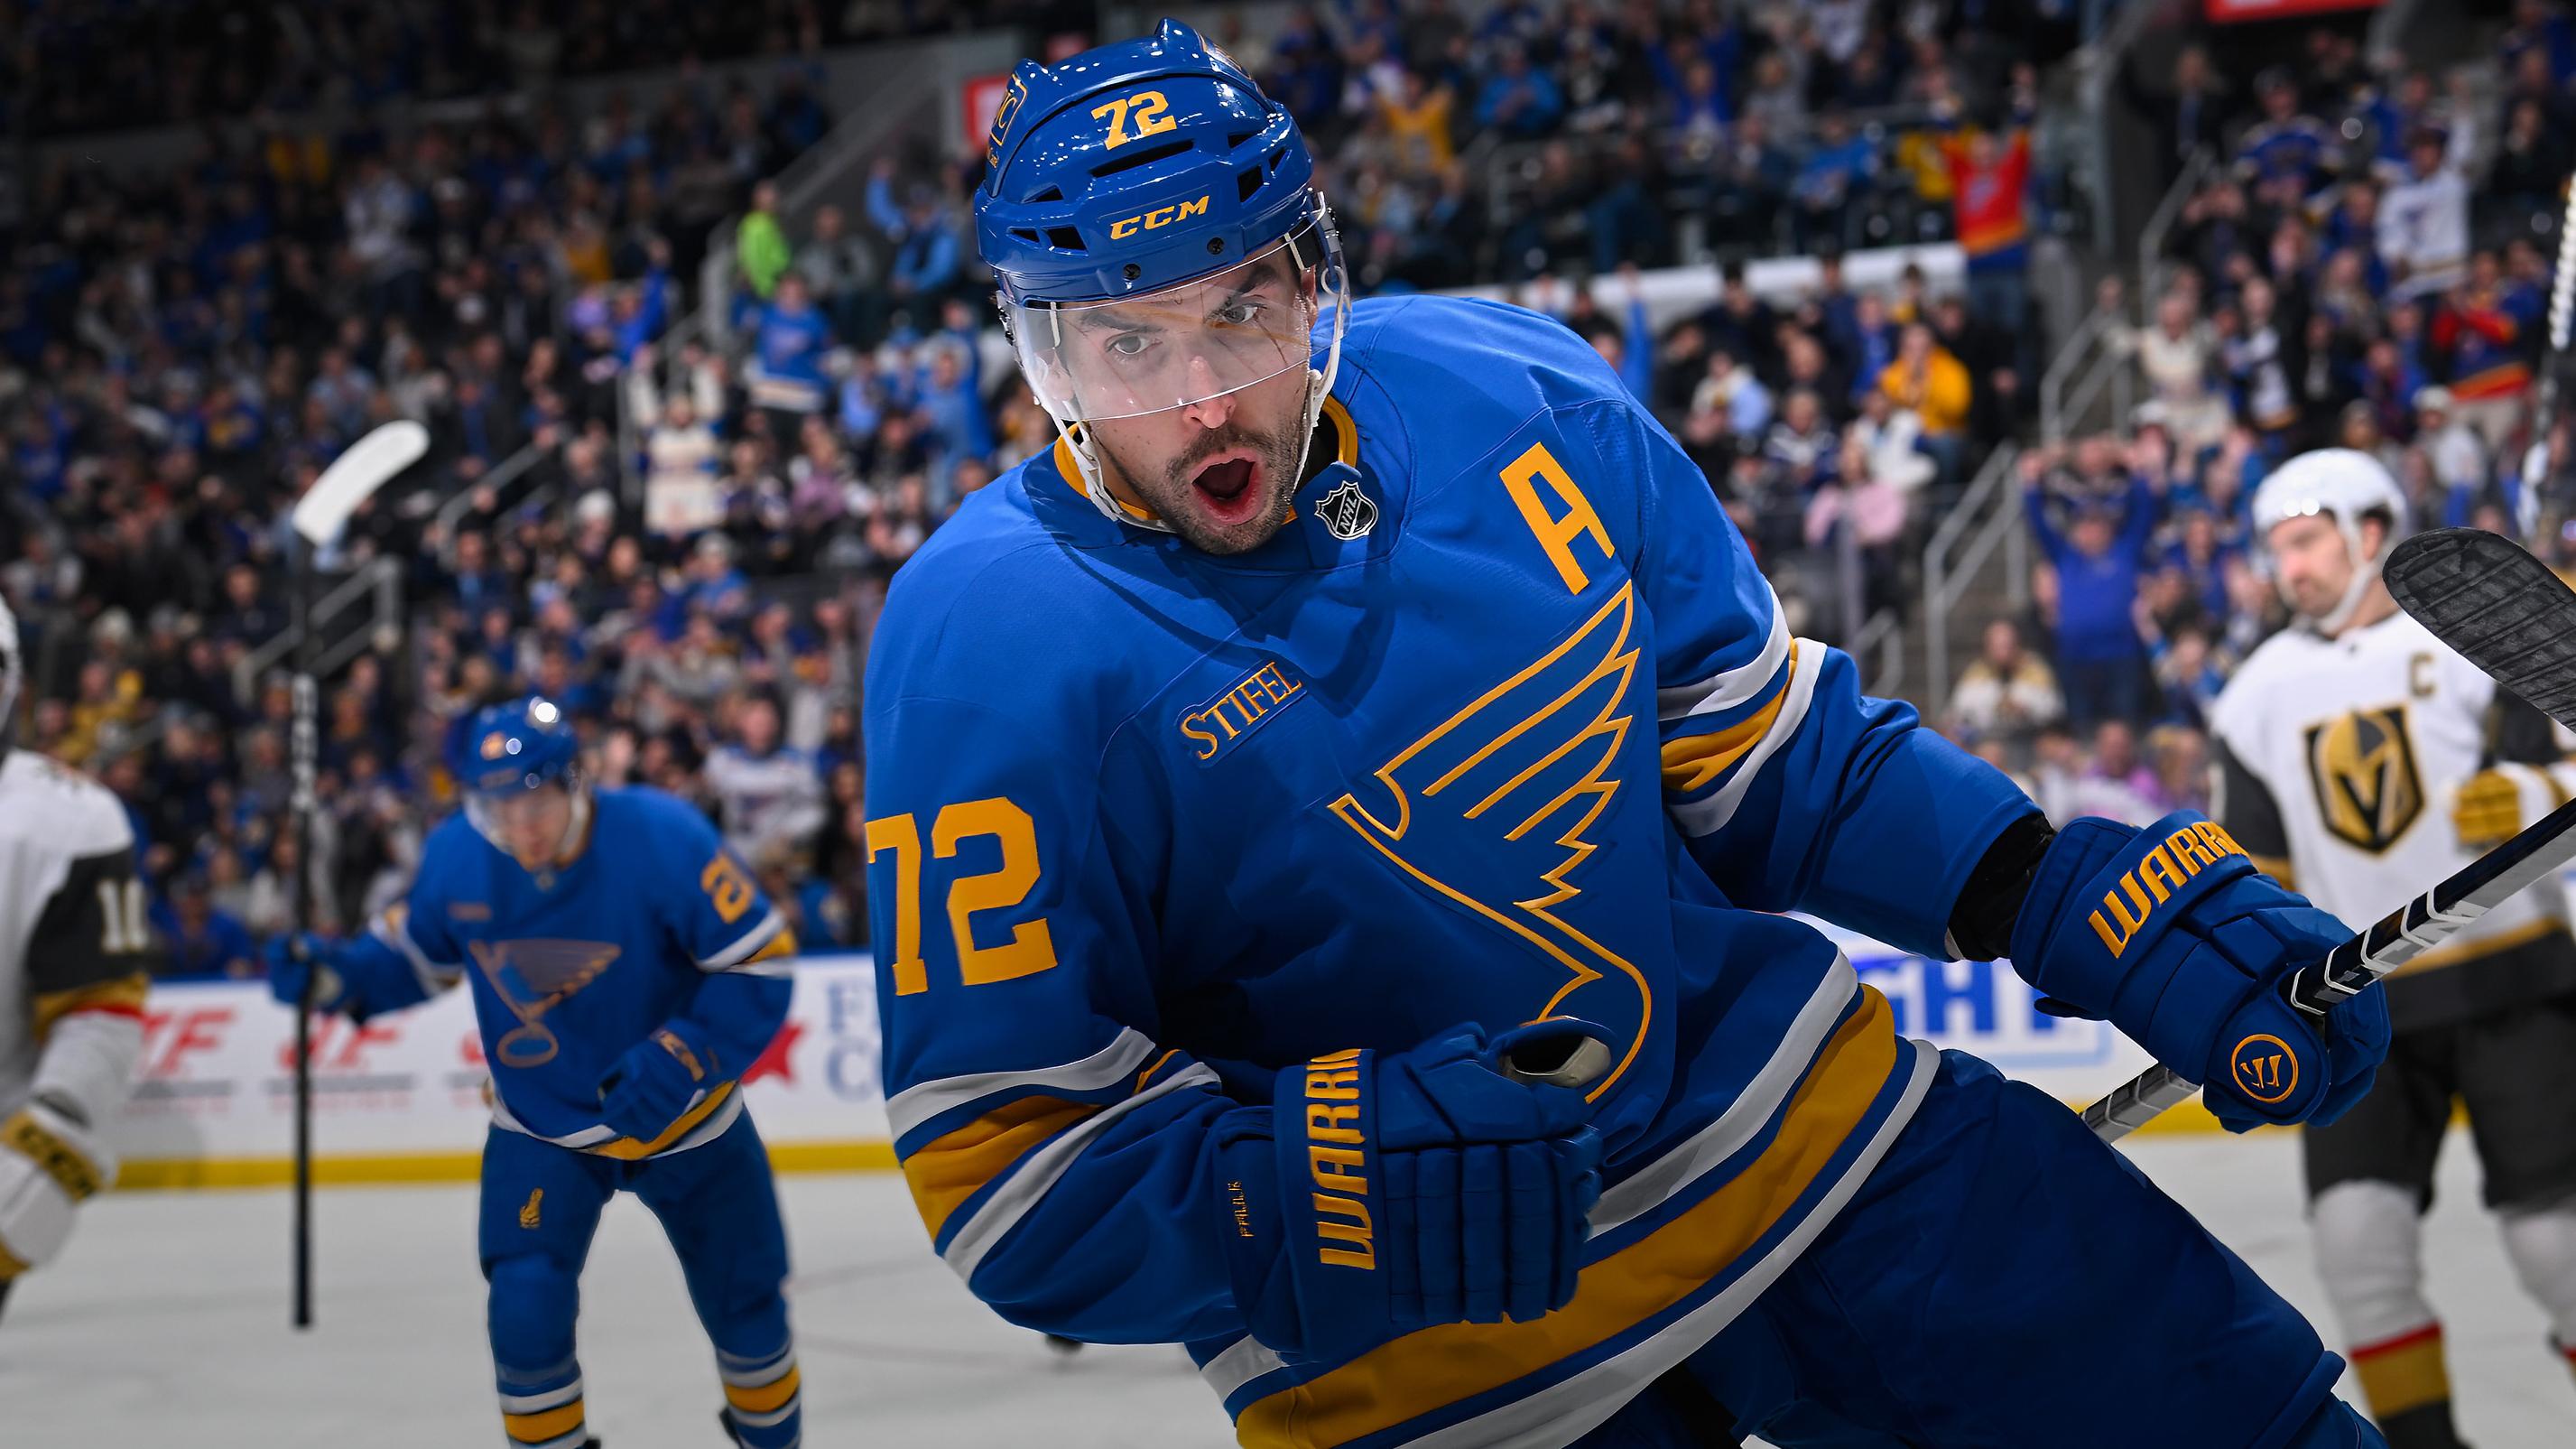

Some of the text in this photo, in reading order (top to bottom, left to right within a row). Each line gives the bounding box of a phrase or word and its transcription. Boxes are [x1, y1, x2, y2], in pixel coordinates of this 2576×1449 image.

[1090, 90, 1177, 150] 72
[1109, 195, 1210, 241] CCM
[1339, 497, 1357, 533] NHL
[1499, 441, 1616, 596] A
[2410, 652, 2439, 697] C
[1181, 661, 1303, 760] STIFEL
[864, 795, 1059, 997] 72
